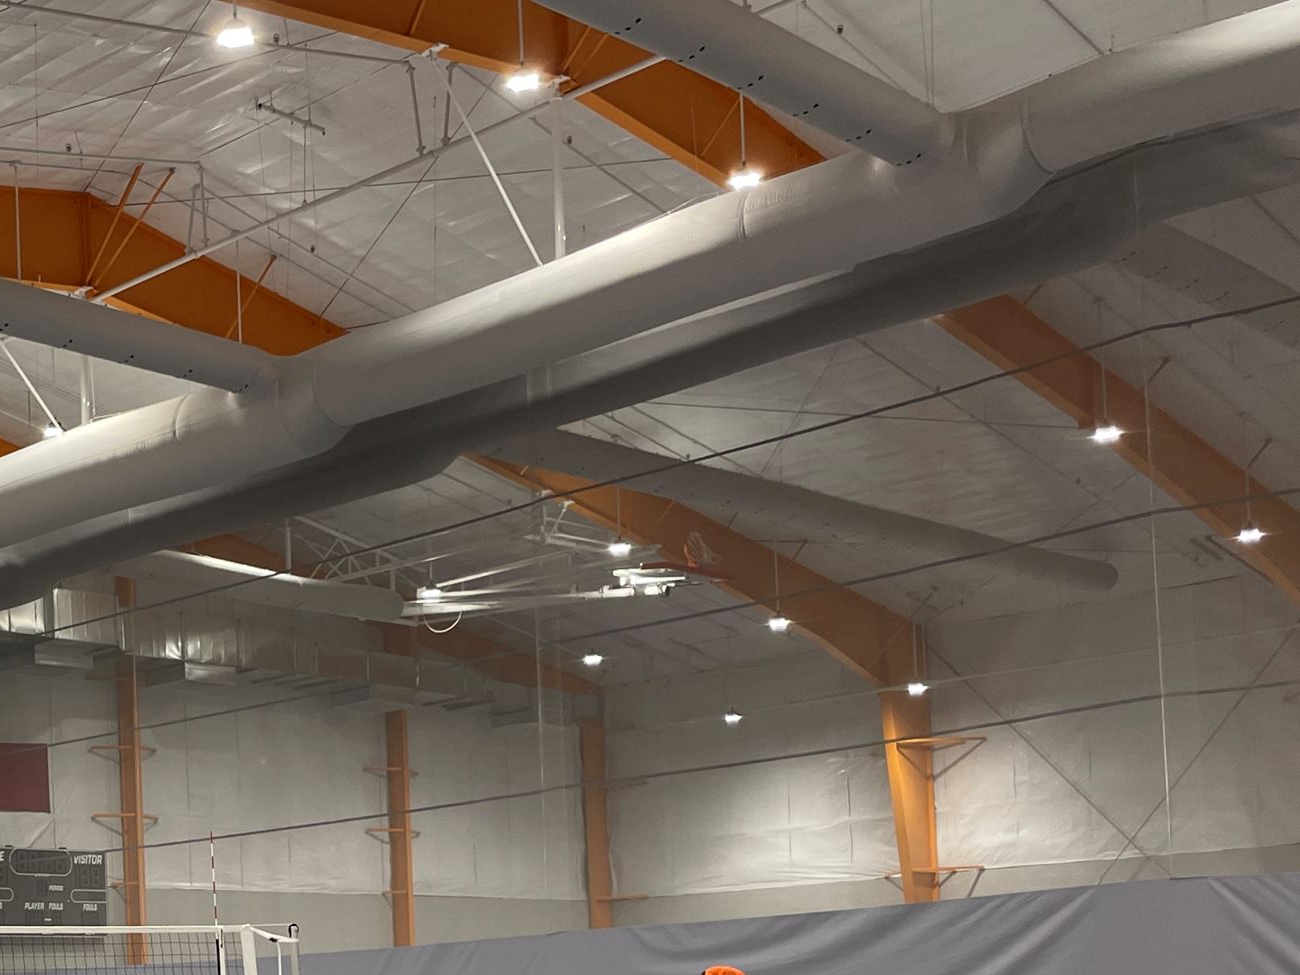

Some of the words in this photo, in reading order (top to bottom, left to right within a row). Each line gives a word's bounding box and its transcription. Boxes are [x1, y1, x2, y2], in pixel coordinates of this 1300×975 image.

[73, 855, 102, 865] VISITOR
[48, 902, 63, 910] FOULS
[83, 903, 97, 911] FOULS
